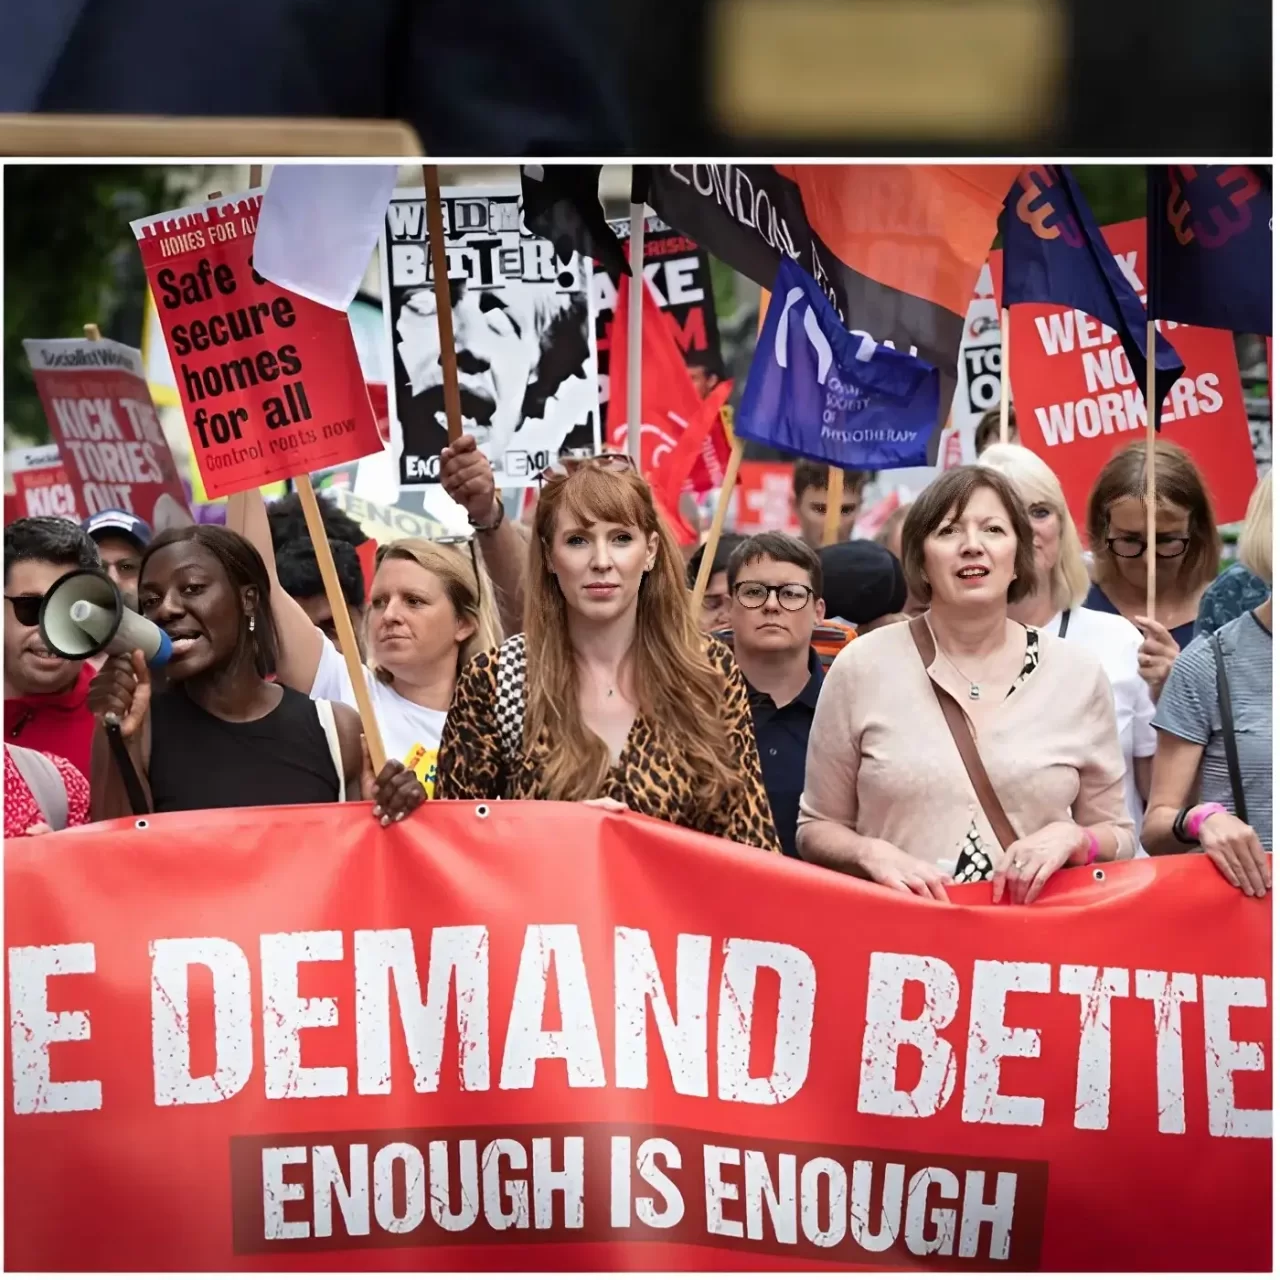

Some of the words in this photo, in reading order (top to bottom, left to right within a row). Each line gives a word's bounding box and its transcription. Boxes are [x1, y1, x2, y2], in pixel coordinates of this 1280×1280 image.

[159, 229, 206, 258] HOMES
[207, 220, 238, 246] FOR
[241, 215, 257, 237] AL
[157, 258, 237, 310] Safe
[171, 296, 297, 357] secure
[181, 344, 303, 403] homes
[1081, 345, 1136, 394] NO
[51, 397, 124, 441] KICK
[193, 407, 249, 449] for
[261, 381, 313, 430] all
[322, 417, 357, 441] now
[64, 440, 164, 484] TORIES
[148, 923, 818, 1106] DEMAND
[856, 950, 1273, 1138] BETTE
[261, 1136, 585, 1240] ENOUGH
[610, 1135, 686, 1230] IS
[702, 1143, 1018, 1261] ENOUGH
